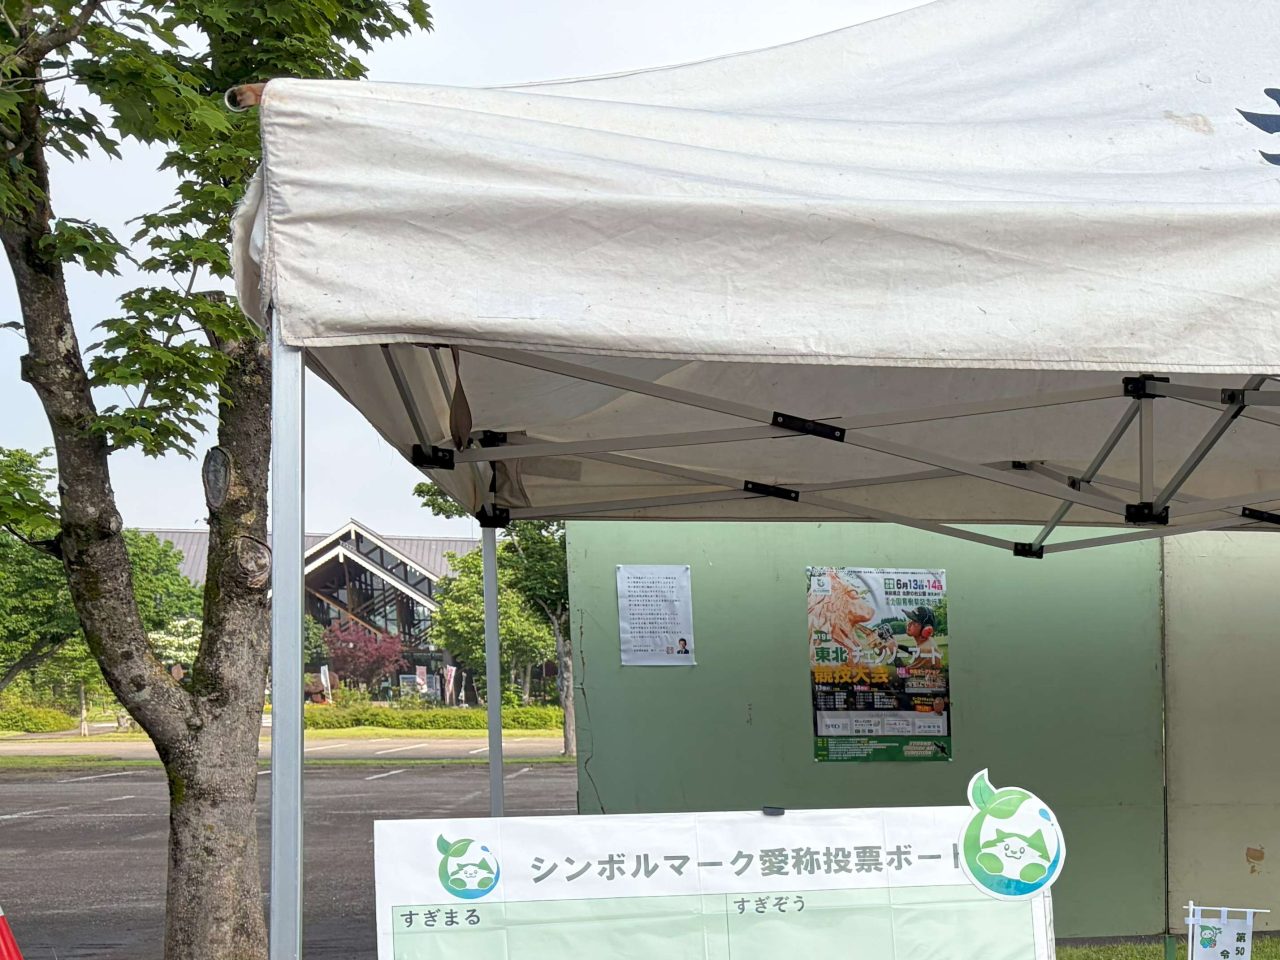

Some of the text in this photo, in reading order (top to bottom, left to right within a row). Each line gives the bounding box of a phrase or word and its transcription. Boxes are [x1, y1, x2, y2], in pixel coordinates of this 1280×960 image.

[733, 894, 806, 914] すぎぞう
[400, 907, 481, 930] すぎまる
